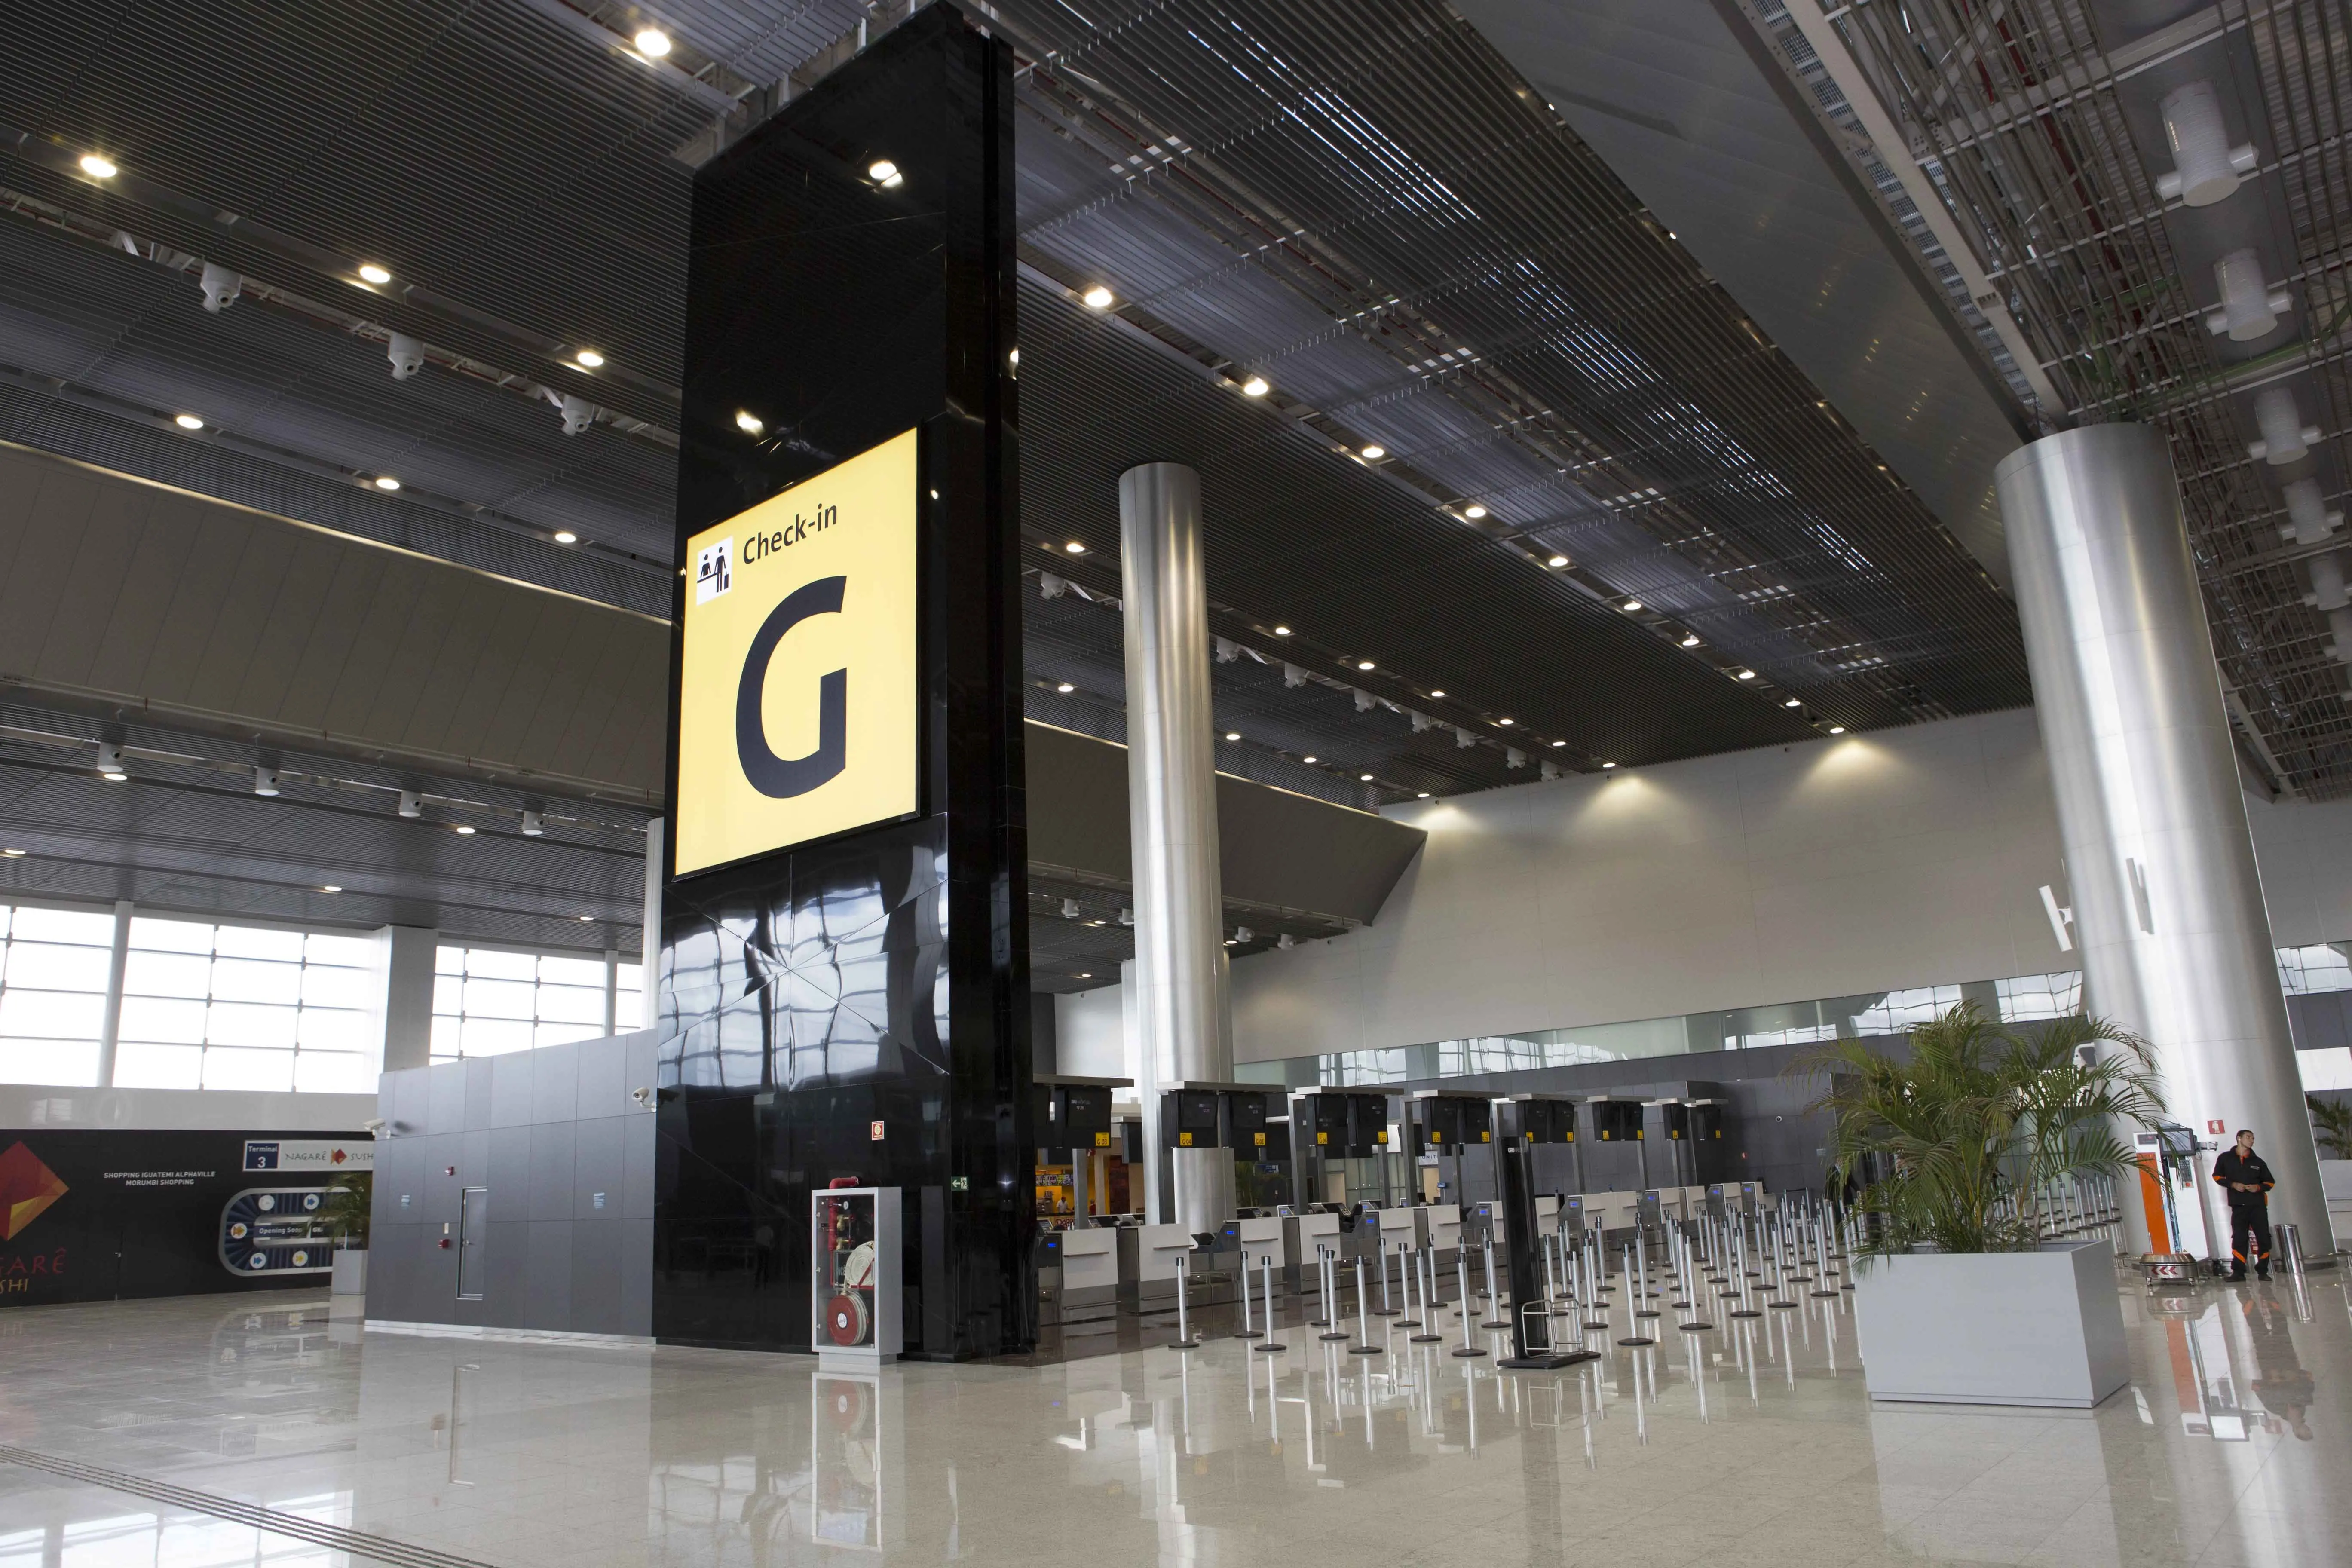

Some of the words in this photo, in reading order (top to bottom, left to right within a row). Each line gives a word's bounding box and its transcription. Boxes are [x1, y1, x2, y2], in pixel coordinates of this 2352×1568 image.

[743, 503, 837, 564] Check-in
[735, 575, 847, 799] G
[257, 1156, 266, 1168] 3
[285, 1151, 327, 1161] NAGARÊ
